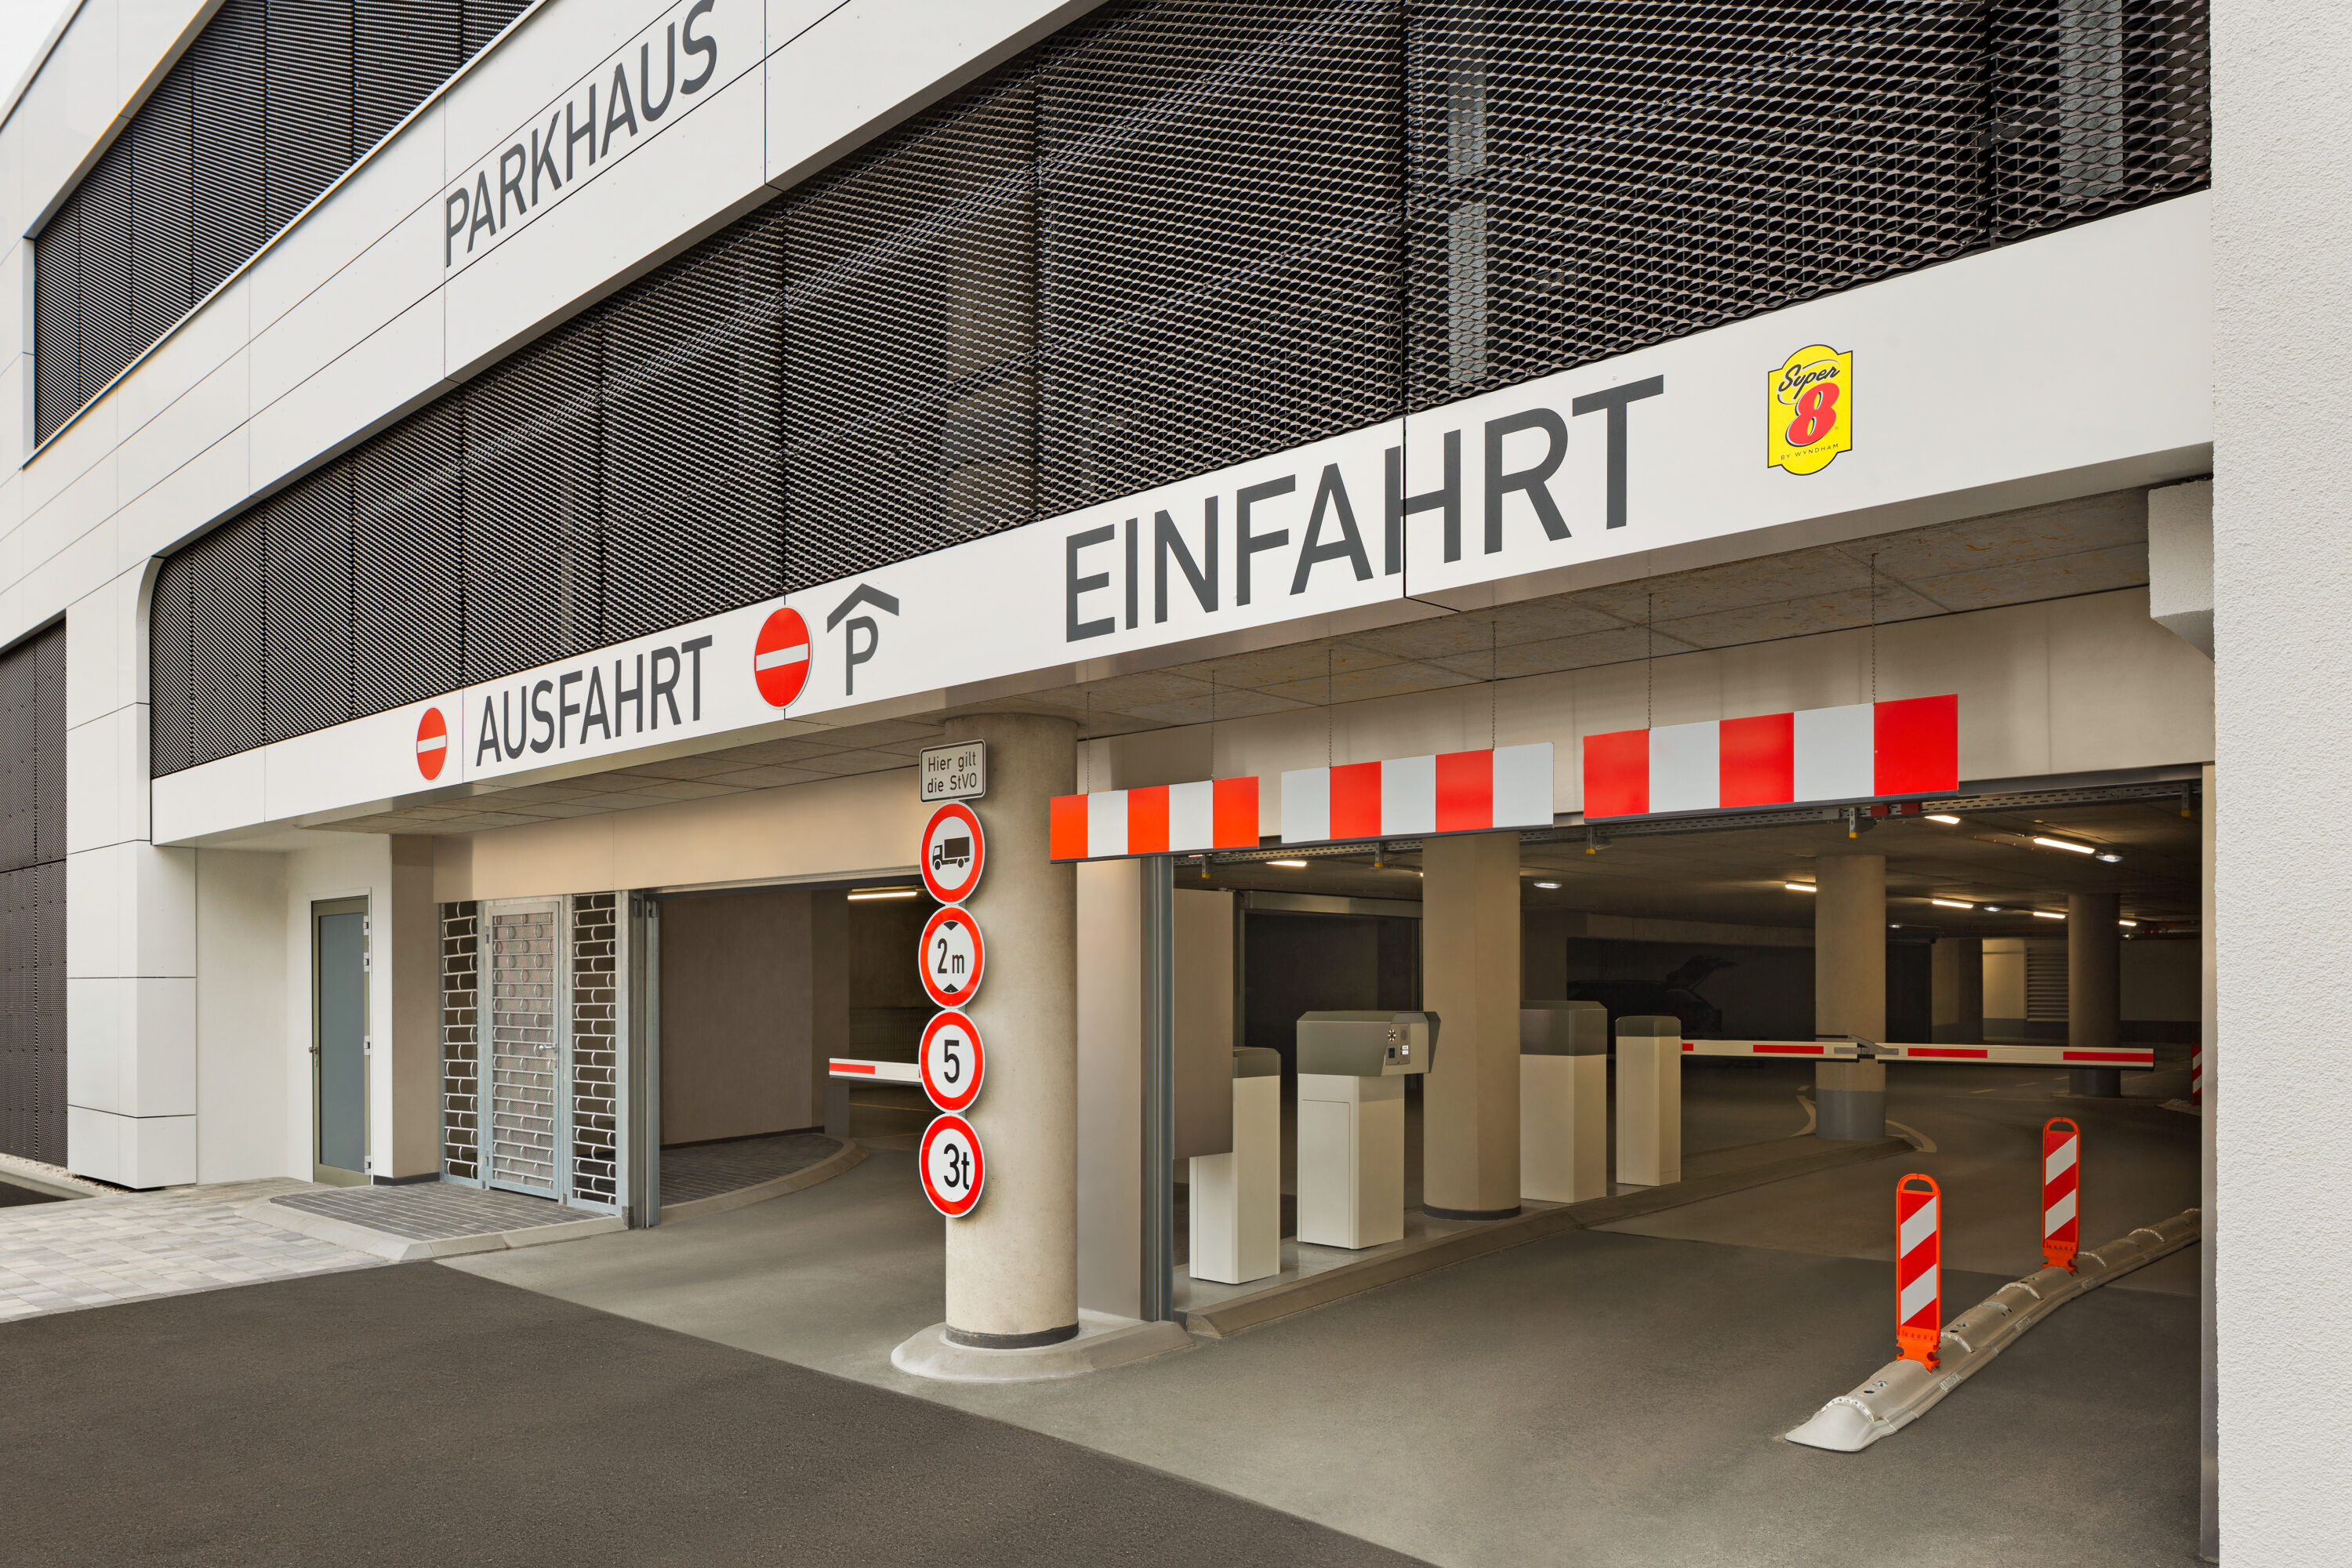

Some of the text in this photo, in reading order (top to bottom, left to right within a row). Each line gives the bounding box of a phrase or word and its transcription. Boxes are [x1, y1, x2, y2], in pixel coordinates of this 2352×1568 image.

[446, 0, 717, 268] PARKHAUS
[1777, 363, 1840, 401] Super
[1784, 382, 1840, 448] 8
[1795, 443, 1838, 457] WYNDHAM
[1066, 374, 1664, 643] EINFAHRT
[845, 615, 879, 696] P
[476, 634, 713, 767] AUSFAHRT
[927, 751, 976, 772] Hier gilt
[927, 772, 977, 793] die StVO
[943, 1040, 960, 1083] 5
